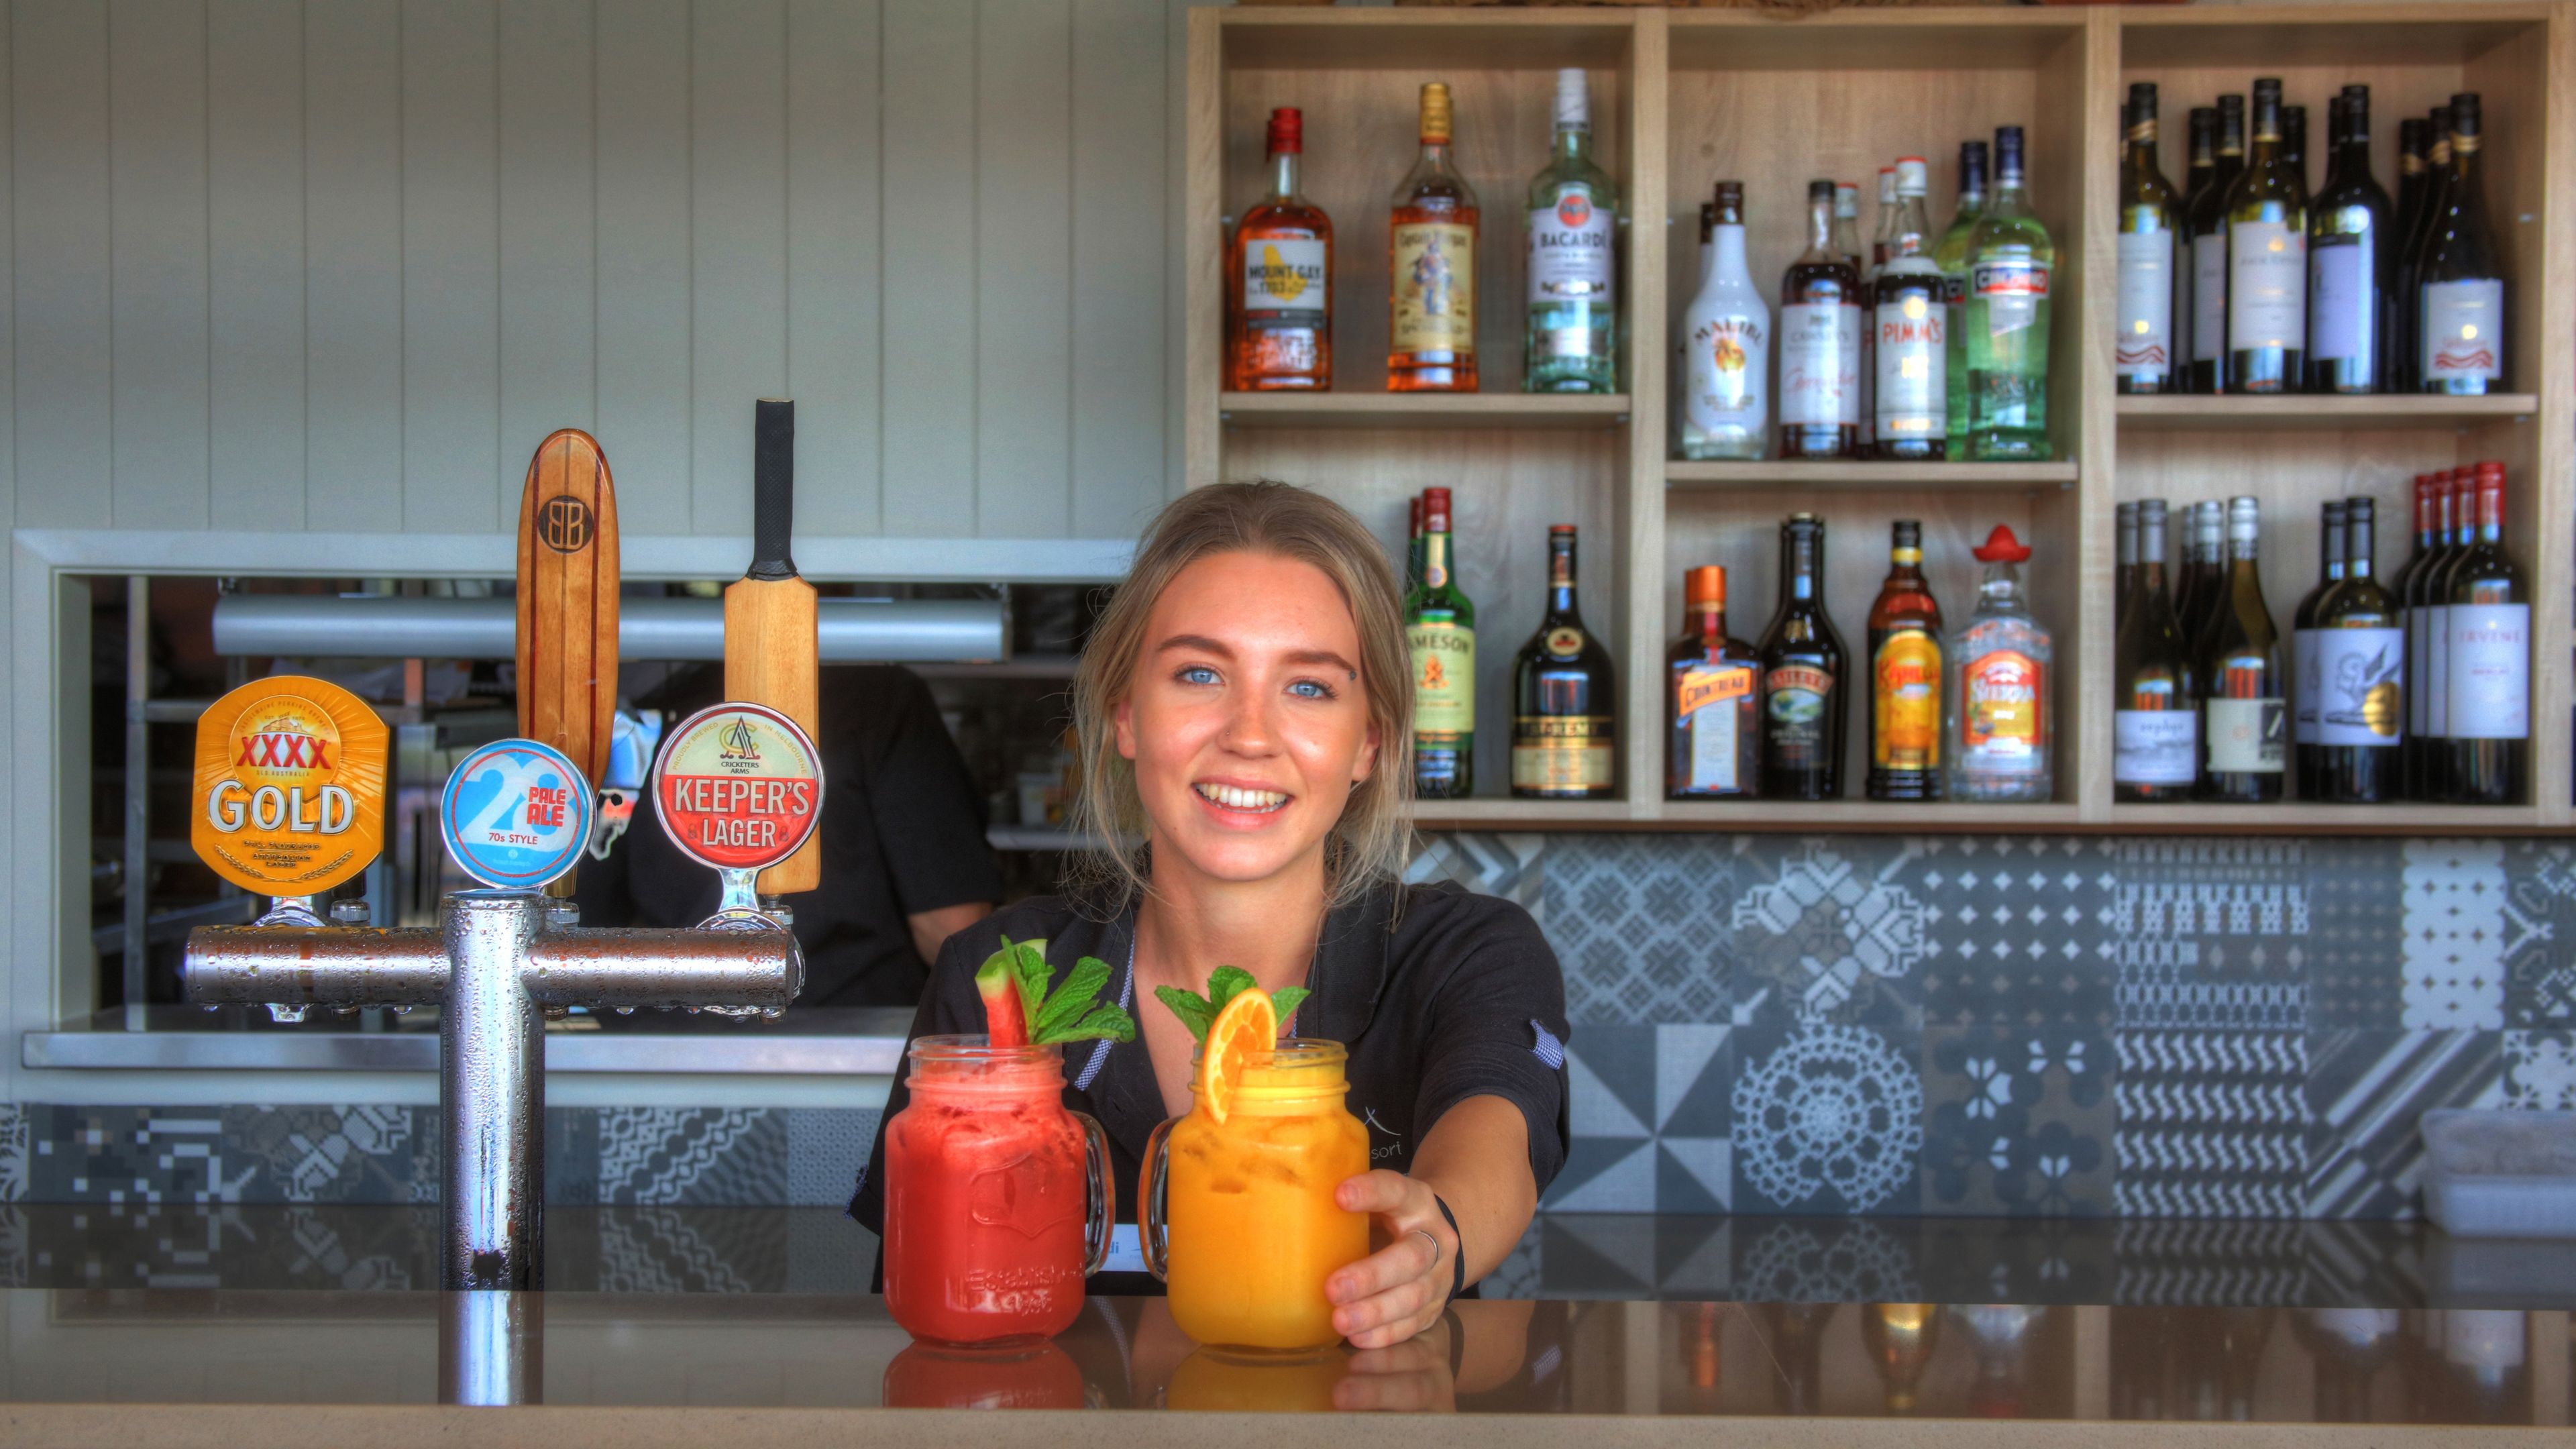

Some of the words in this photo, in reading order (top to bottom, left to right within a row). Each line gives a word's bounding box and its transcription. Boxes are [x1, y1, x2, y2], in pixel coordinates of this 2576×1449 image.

[1248, 264, 1293, 279] MOUNT
[1297, 264, 1320, 279] GAY
[1882, 317, 1942, 344] PIMM'S
[236, 734, 331, 769] XXXX
[673, 741, 691, 770] PROUDLY
[691, 722, 718, 741] BREWED
[775, 730, 807, 774] MELBOURNE
[208, 779, 354, 835] GOLD
[529, 786, 566, 805] PALE
[675, 778, 809, 815] KEEPER'S
[527, 804, 565, 827] ALE
[489, 832, 505, 842] 70s
[509, 834, 538, 845] STYLE
[703, 818, 776, 847] LAGER
[244, 840, 265, 848] FULL
[268, 841, 321, 850] FLAVOURED
[253, 853, 311, 862] AUSTRALIAN
[266, 860, 296, 868] LAGER
